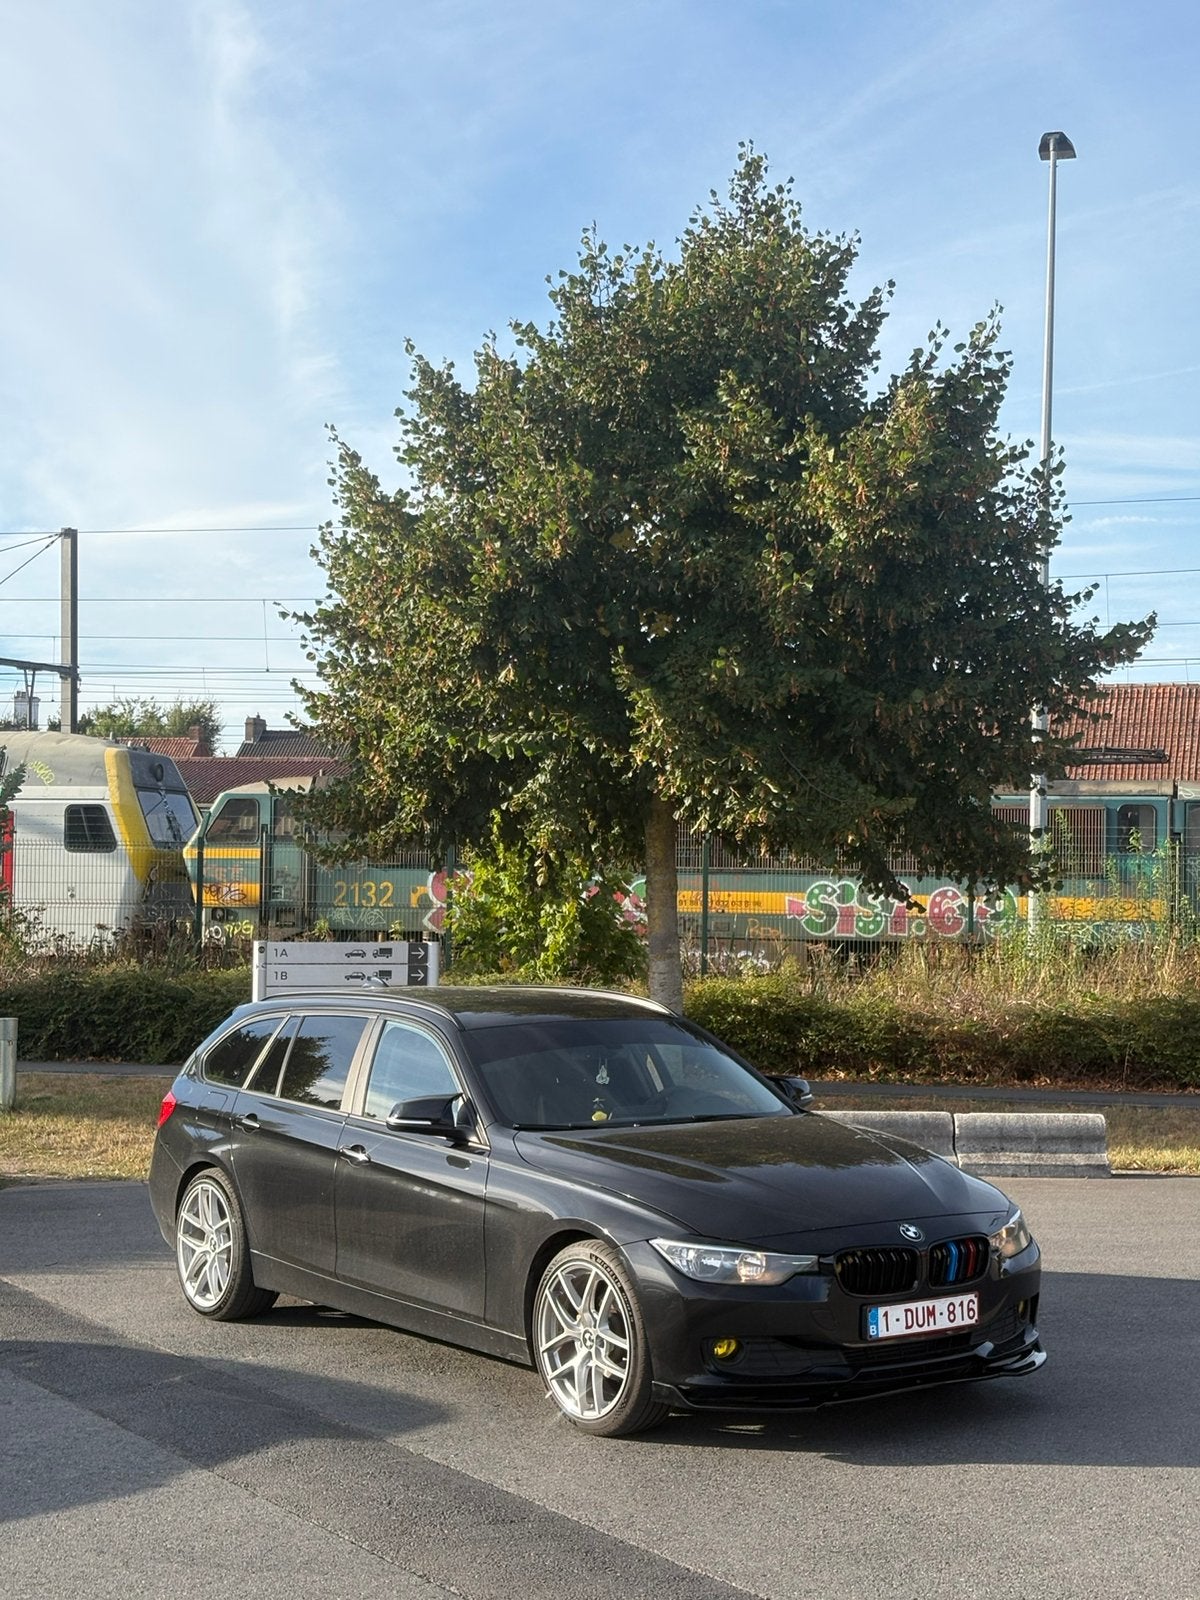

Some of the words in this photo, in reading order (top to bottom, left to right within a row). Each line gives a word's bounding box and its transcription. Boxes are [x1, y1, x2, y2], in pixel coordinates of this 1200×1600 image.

[334, 881, 394, 907] 2132
[274, 948, 288, 958] 1A
[274, 971, 288, 981] 1B
[882, 1299, 976, 1333] 1-DUM-816
[869, 1325, 877, 1336] B
